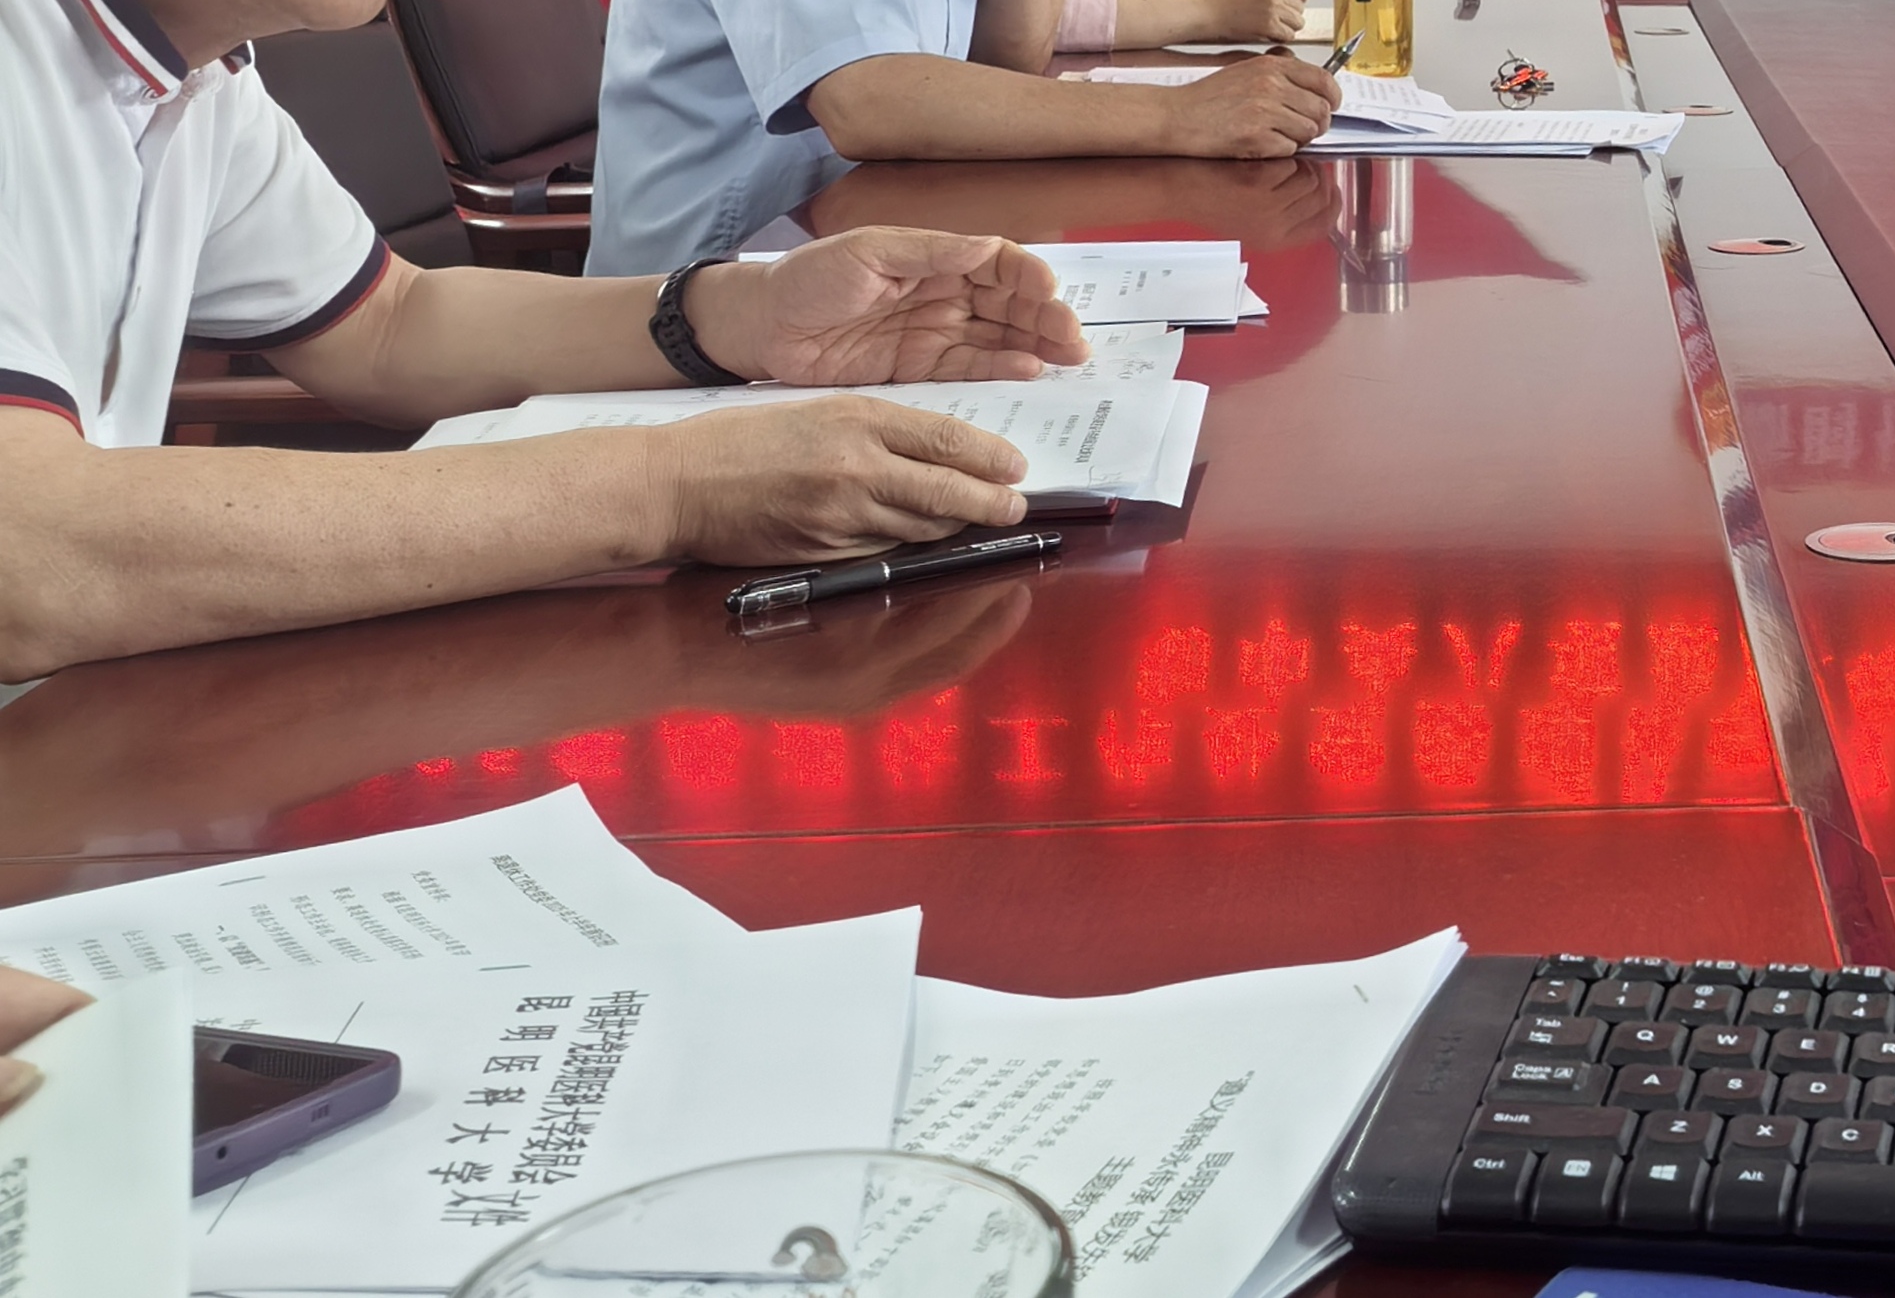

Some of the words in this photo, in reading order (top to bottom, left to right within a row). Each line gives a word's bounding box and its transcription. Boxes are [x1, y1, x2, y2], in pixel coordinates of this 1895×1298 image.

[1559, 953, 1584, 962] Esc
[1617, 995, 1626, 1005] 1
[1693, 999, 1706, 1009] 2
[1772, 1003, 1786, 1014] 3
[1852, 1007, 1865, 1017] 4
[1536, 1018, 1562, 1028] Tab
[1636, 1029, 1655, 1042] Q
[1717, 1034, 1739, 1046] W
[1800, 1038, 1815, 1050] E
[1643, 1074, 1661, 1085] A
[1727, 1078, 1743, 1090] S
[427, 994, 576, 1186] 昆明医科大学
[508, 989, 651, 1186] 中国共产党昆明医科大学委员会
[1809, 1081, 1827, 1094] D
[1493, 1112, 1531, 1123] Shift
[1670, 1120, 1688, 1133] Z
[1756, 1124, 1773, 1137] X
[1841, 1128, 1859, 1141] C
[1473, 1158, 1505, 1169] Ctrl
[1738, 1170, 1764, 1181] Alt
[439, 1189, 542, 1228] 文件
[1123, 1151, 1236, 1264] 昆明医科大学
